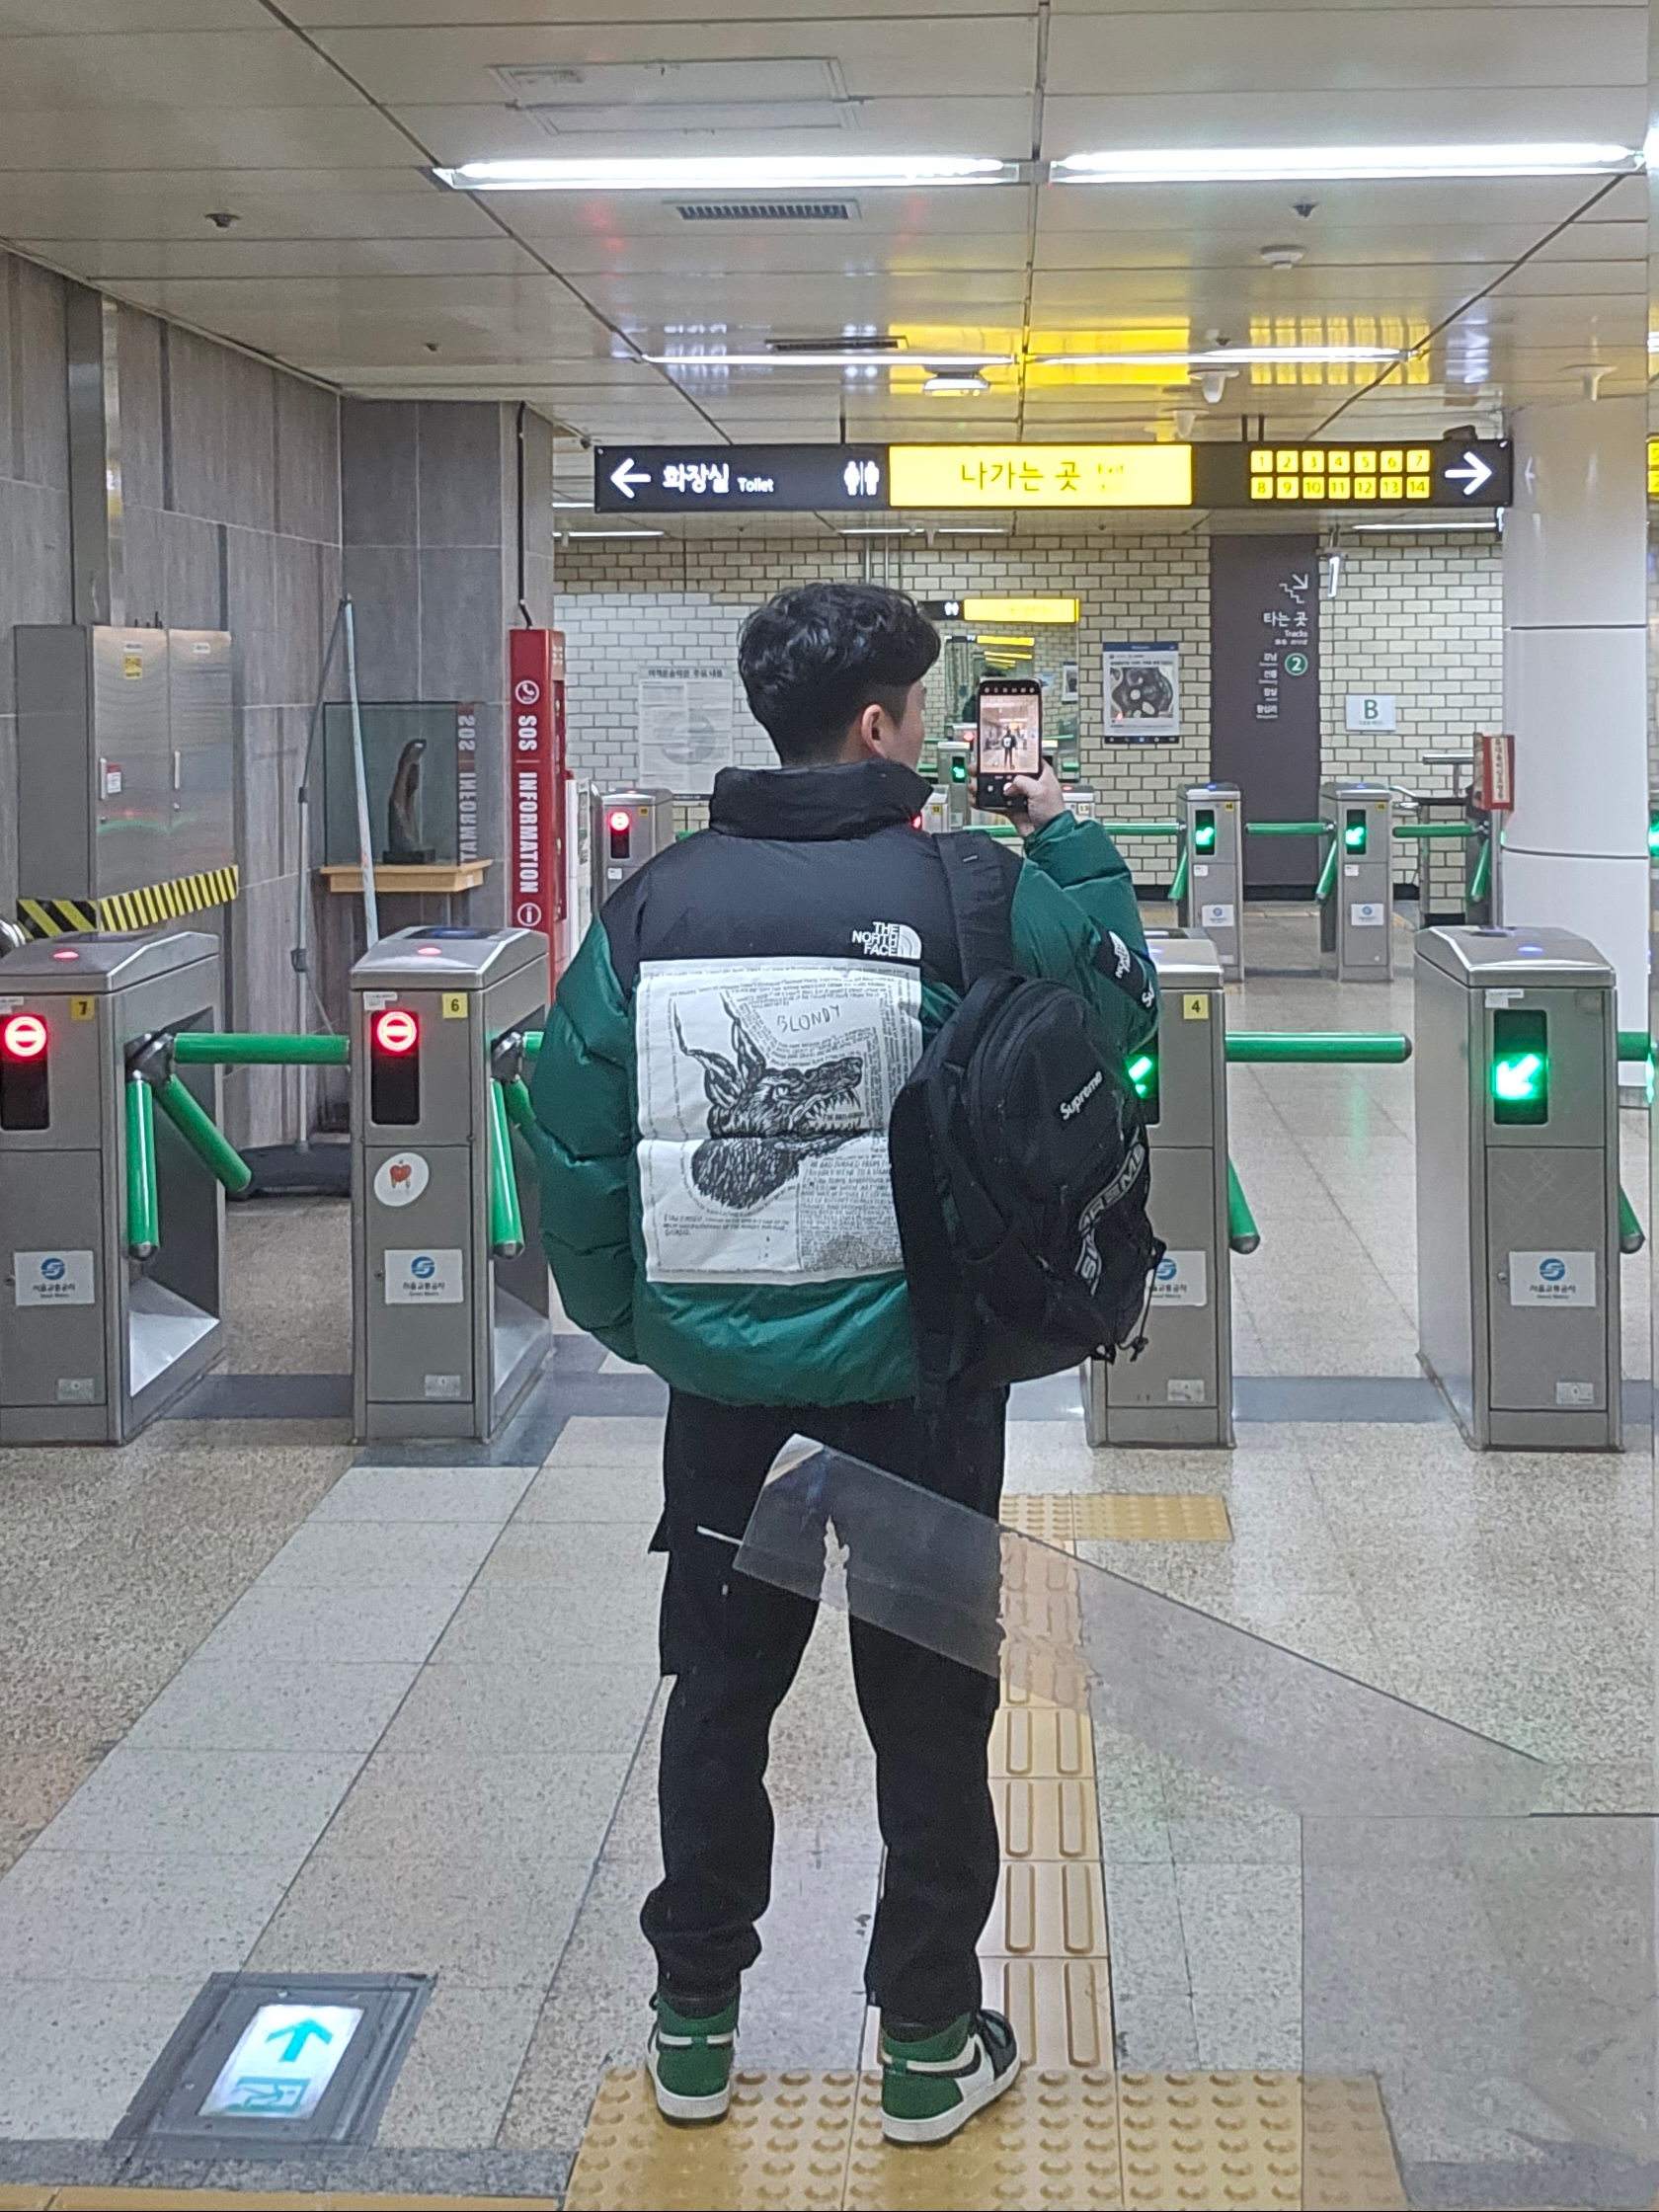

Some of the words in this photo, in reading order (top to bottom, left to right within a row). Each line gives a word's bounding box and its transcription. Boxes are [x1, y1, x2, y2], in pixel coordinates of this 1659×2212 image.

[1284, 456, 1291, 468] 2
[1310, 456, 1317, 468] 3
[1334, 456, 1343, 467] 4
[1362, 456, 1370, 468] 5
[1387, 456, 1396, 468] 6
[1415, 455, 1423, 467] 7
[663, 463, 729, 493] 화장실
[961, 461, 1044, 491] 나가는
[1055, 461, 1080, 491] 곳
[737, 477, 774, 492] Toilet
[1257, 481, 1266, 494] 8
[1283, 481, 1292, 494] 9
[1304, 481, 1321, 494] 10
[1332, 482, 1344, 493] 11
[1358, 482, 1372, 494] 12
[1383, 481, 1398, 494] 13
[1409, 481, 1425, 493] 14
[1263, 610, 1291, 627] 타는
[1294, 610, 1308, 627] 곳
[1291, 657, 1303, 672] 2
[1364, 699, 1379, 720] B
[517, 715, 537, 751] SOS
[518, 772, 538, 893] INFORMATION
[872, 921, 900, 934] THE
[851, 929, 898, 948] NORTH
[863, 942, 899, 957] FACE
[78, 1000, 88, 1016] 7
[450, 998, 460, 1012] 6
[1191, 999, 1201, 1014] 4
[1060, 1070, 1103, 1121] Supreme
